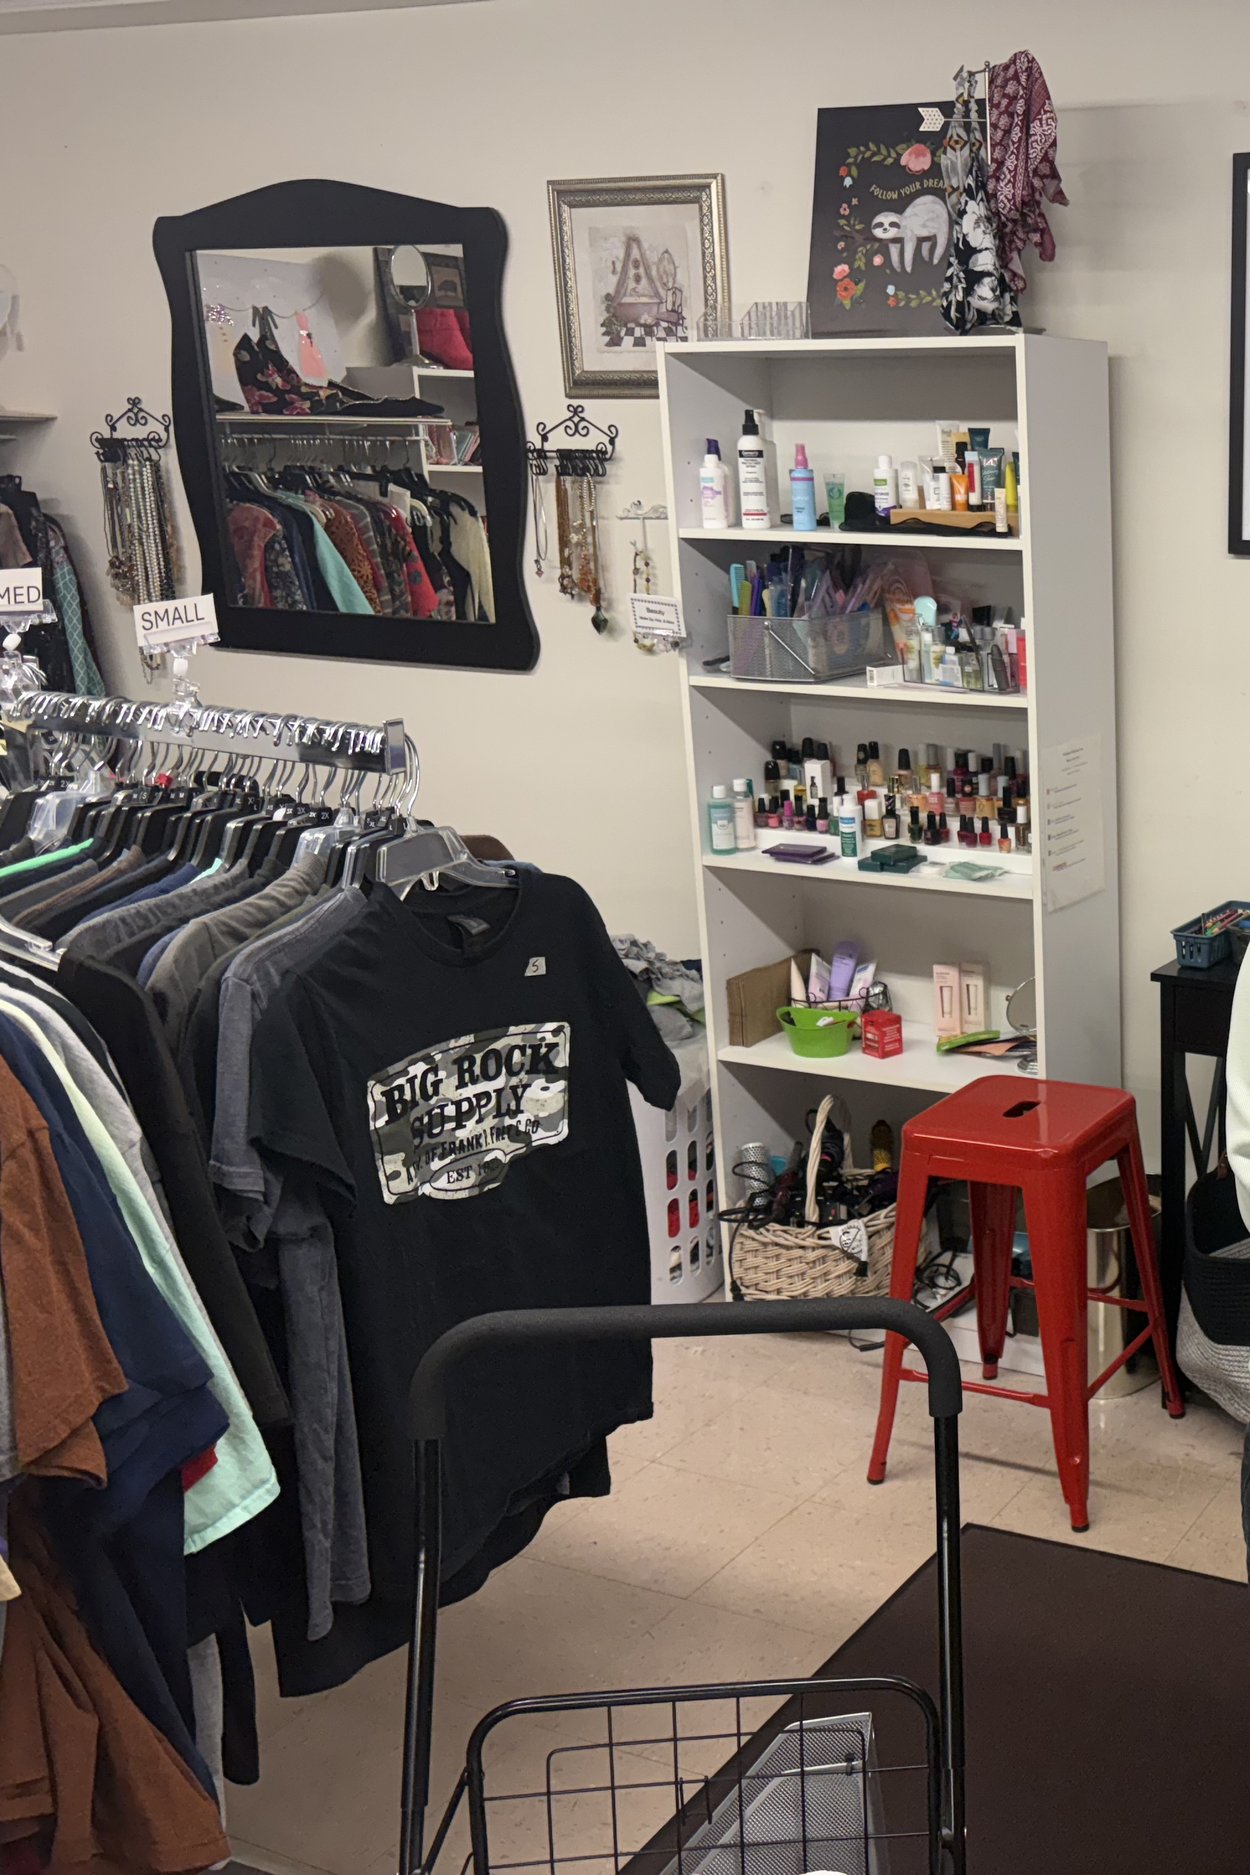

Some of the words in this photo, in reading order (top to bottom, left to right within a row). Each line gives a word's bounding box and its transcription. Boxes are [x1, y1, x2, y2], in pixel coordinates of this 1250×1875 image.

[869, 184, 898, 199] FOLLOW
[900, 181, 921, 197] YOUR
[924, 179, 946, 189] DREA
[0, 586, 40, 604] MED
[141, 605, 205, 631] SMALL
[381, 1065, 443, 1125] BIG
[452, 1042, 559, 1090] ROCK
[410, 1084, 531, 1146] SUPPLY
[447, 1166, 473, 1184] EST
